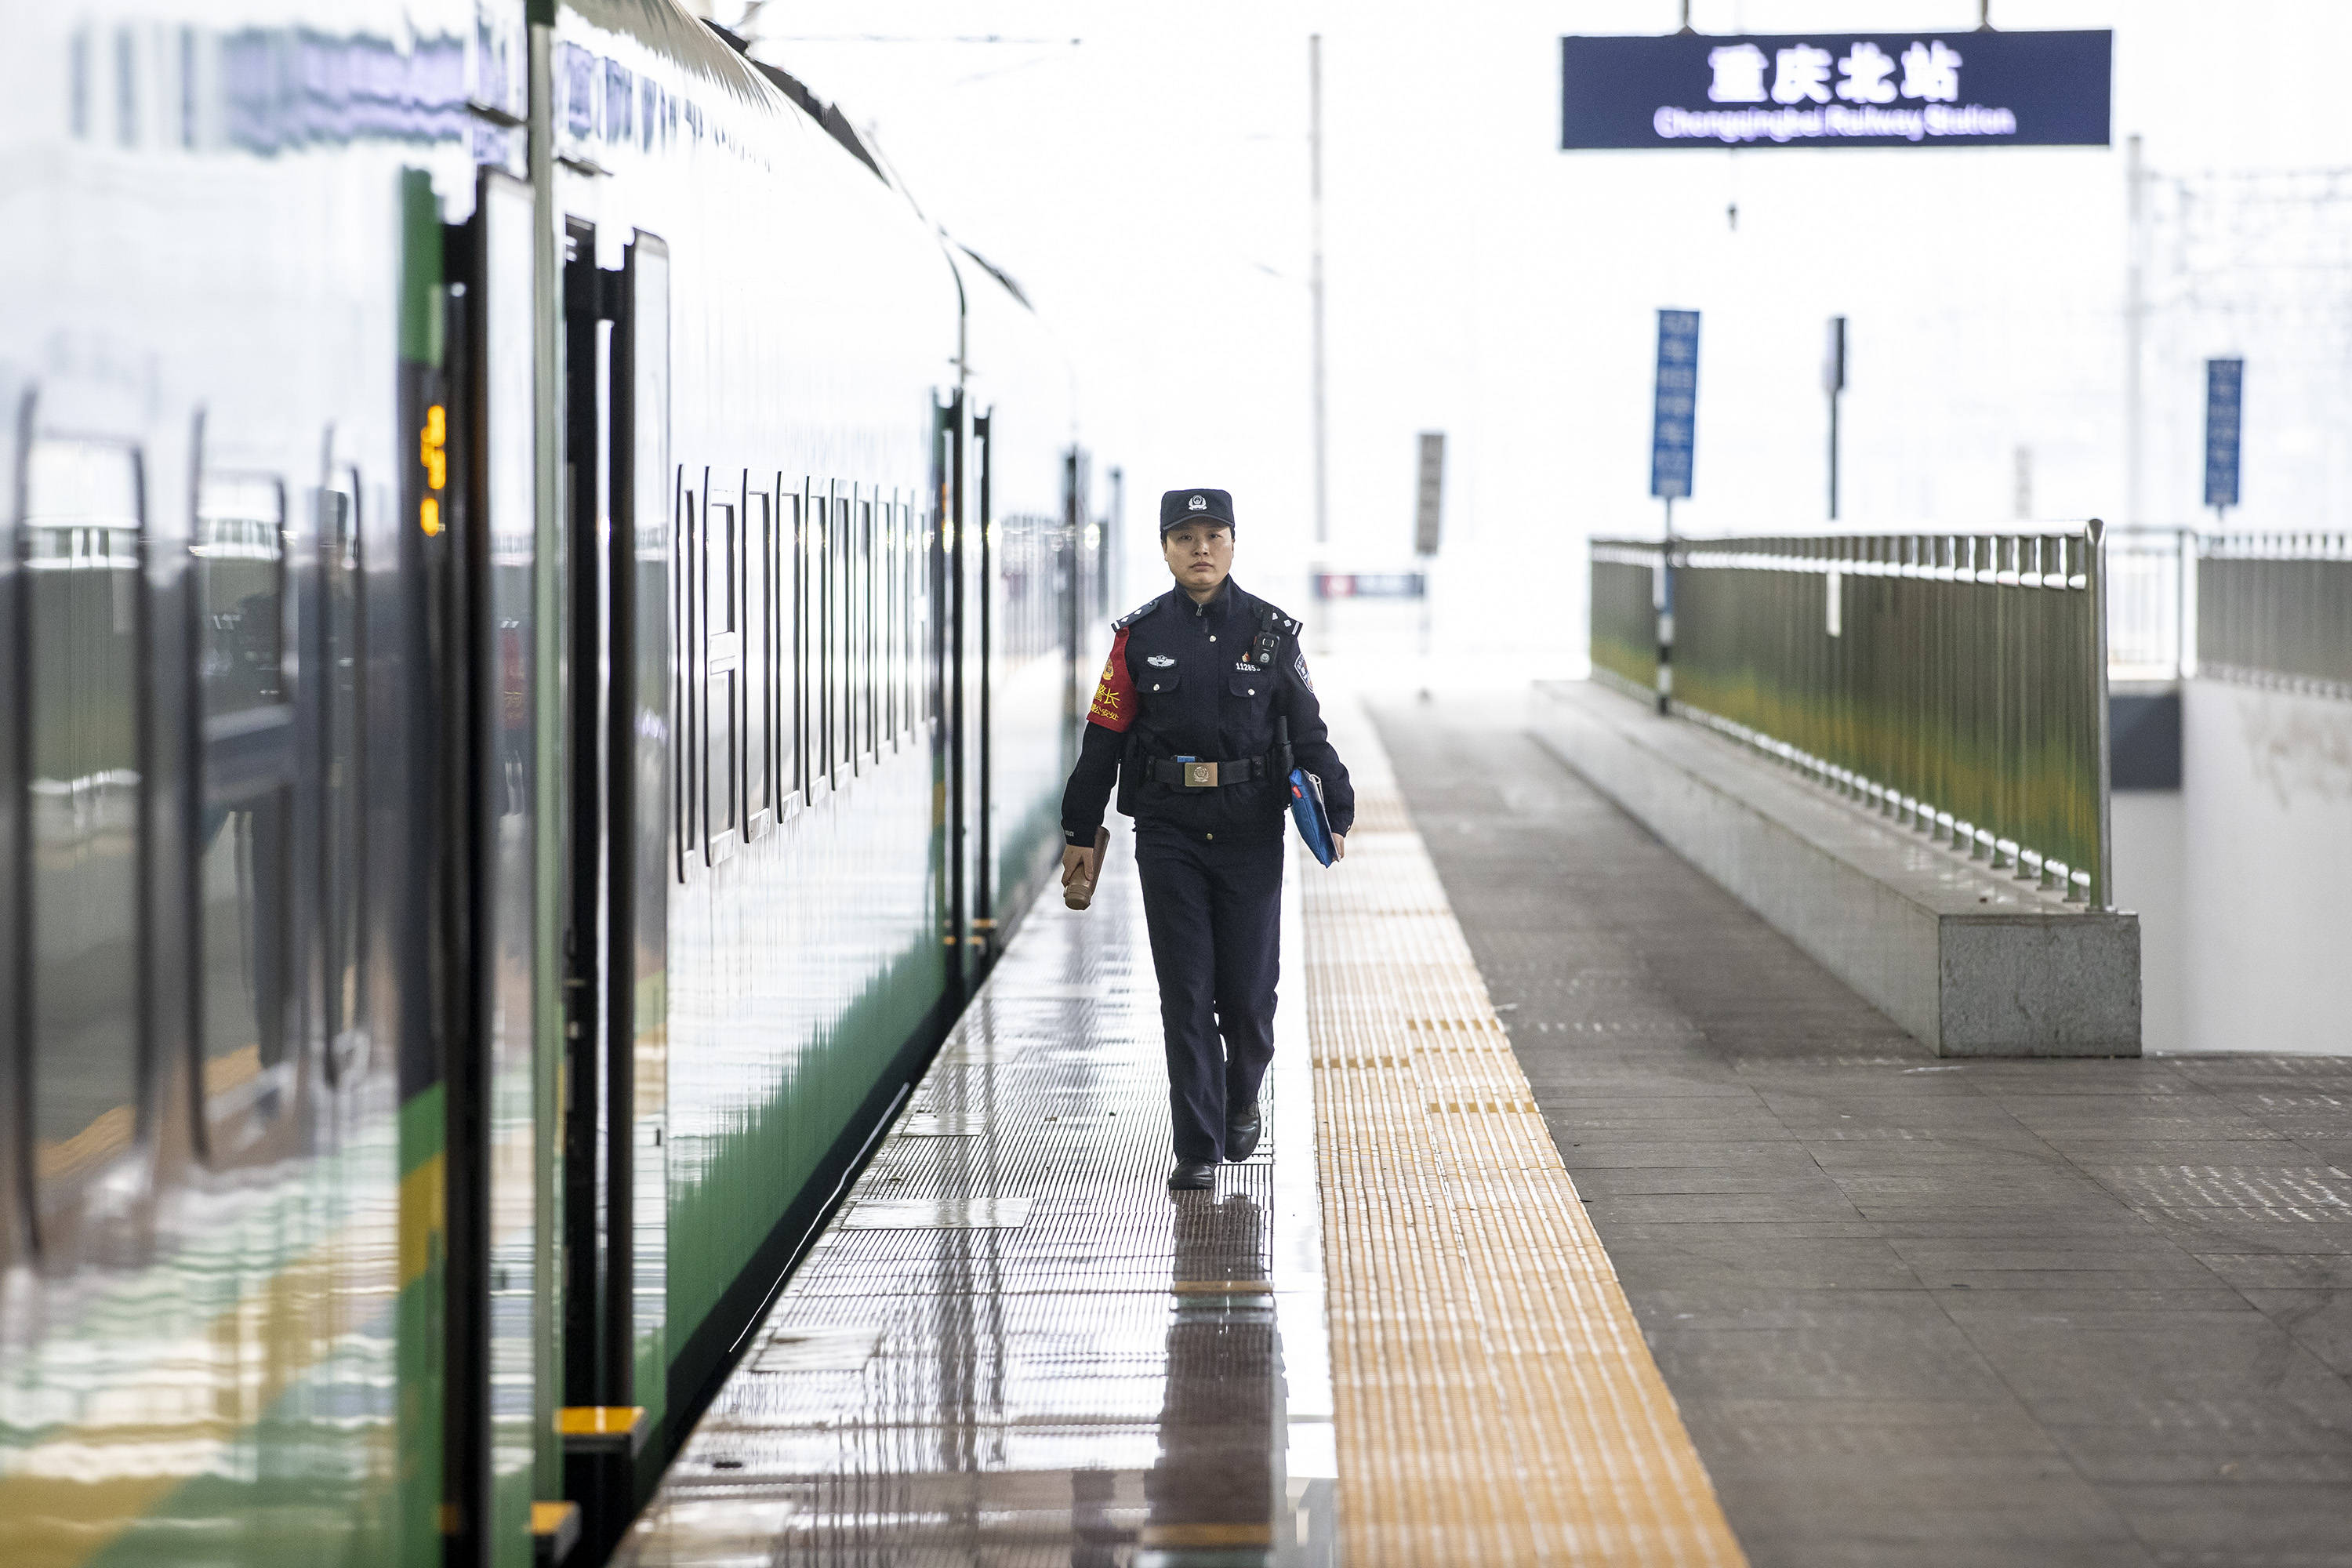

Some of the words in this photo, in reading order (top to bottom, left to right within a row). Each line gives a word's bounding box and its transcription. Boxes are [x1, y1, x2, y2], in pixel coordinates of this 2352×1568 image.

[1708, 40, 1962, 103] 重庆北站
[1825, 104, 1924, 141] Railway
[1924, 103, 2016, 136] Station
